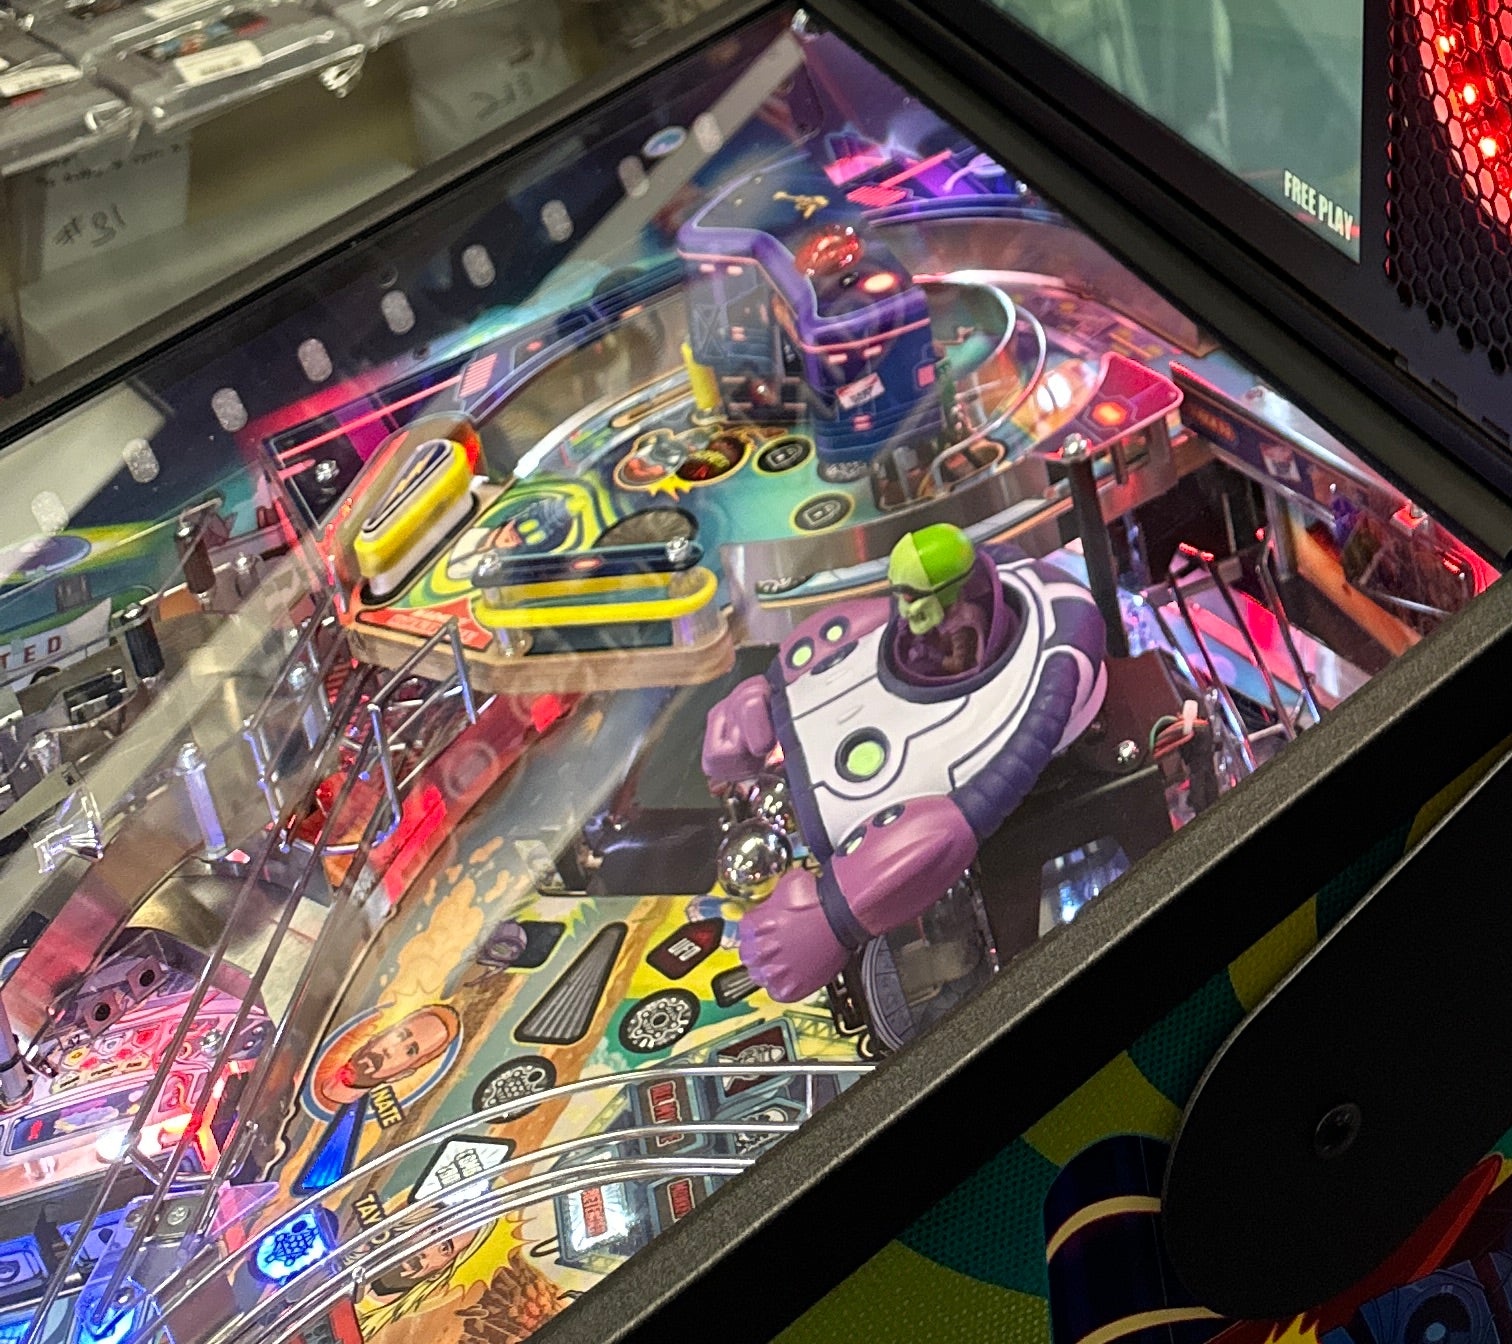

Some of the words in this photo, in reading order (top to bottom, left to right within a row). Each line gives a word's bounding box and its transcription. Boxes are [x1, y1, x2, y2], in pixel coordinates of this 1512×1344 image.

[1284, 169, 1316, 216] FREE
[1318, 193, 1354, 241] PLAY
[371, 1085, 403, 1129] NATE
